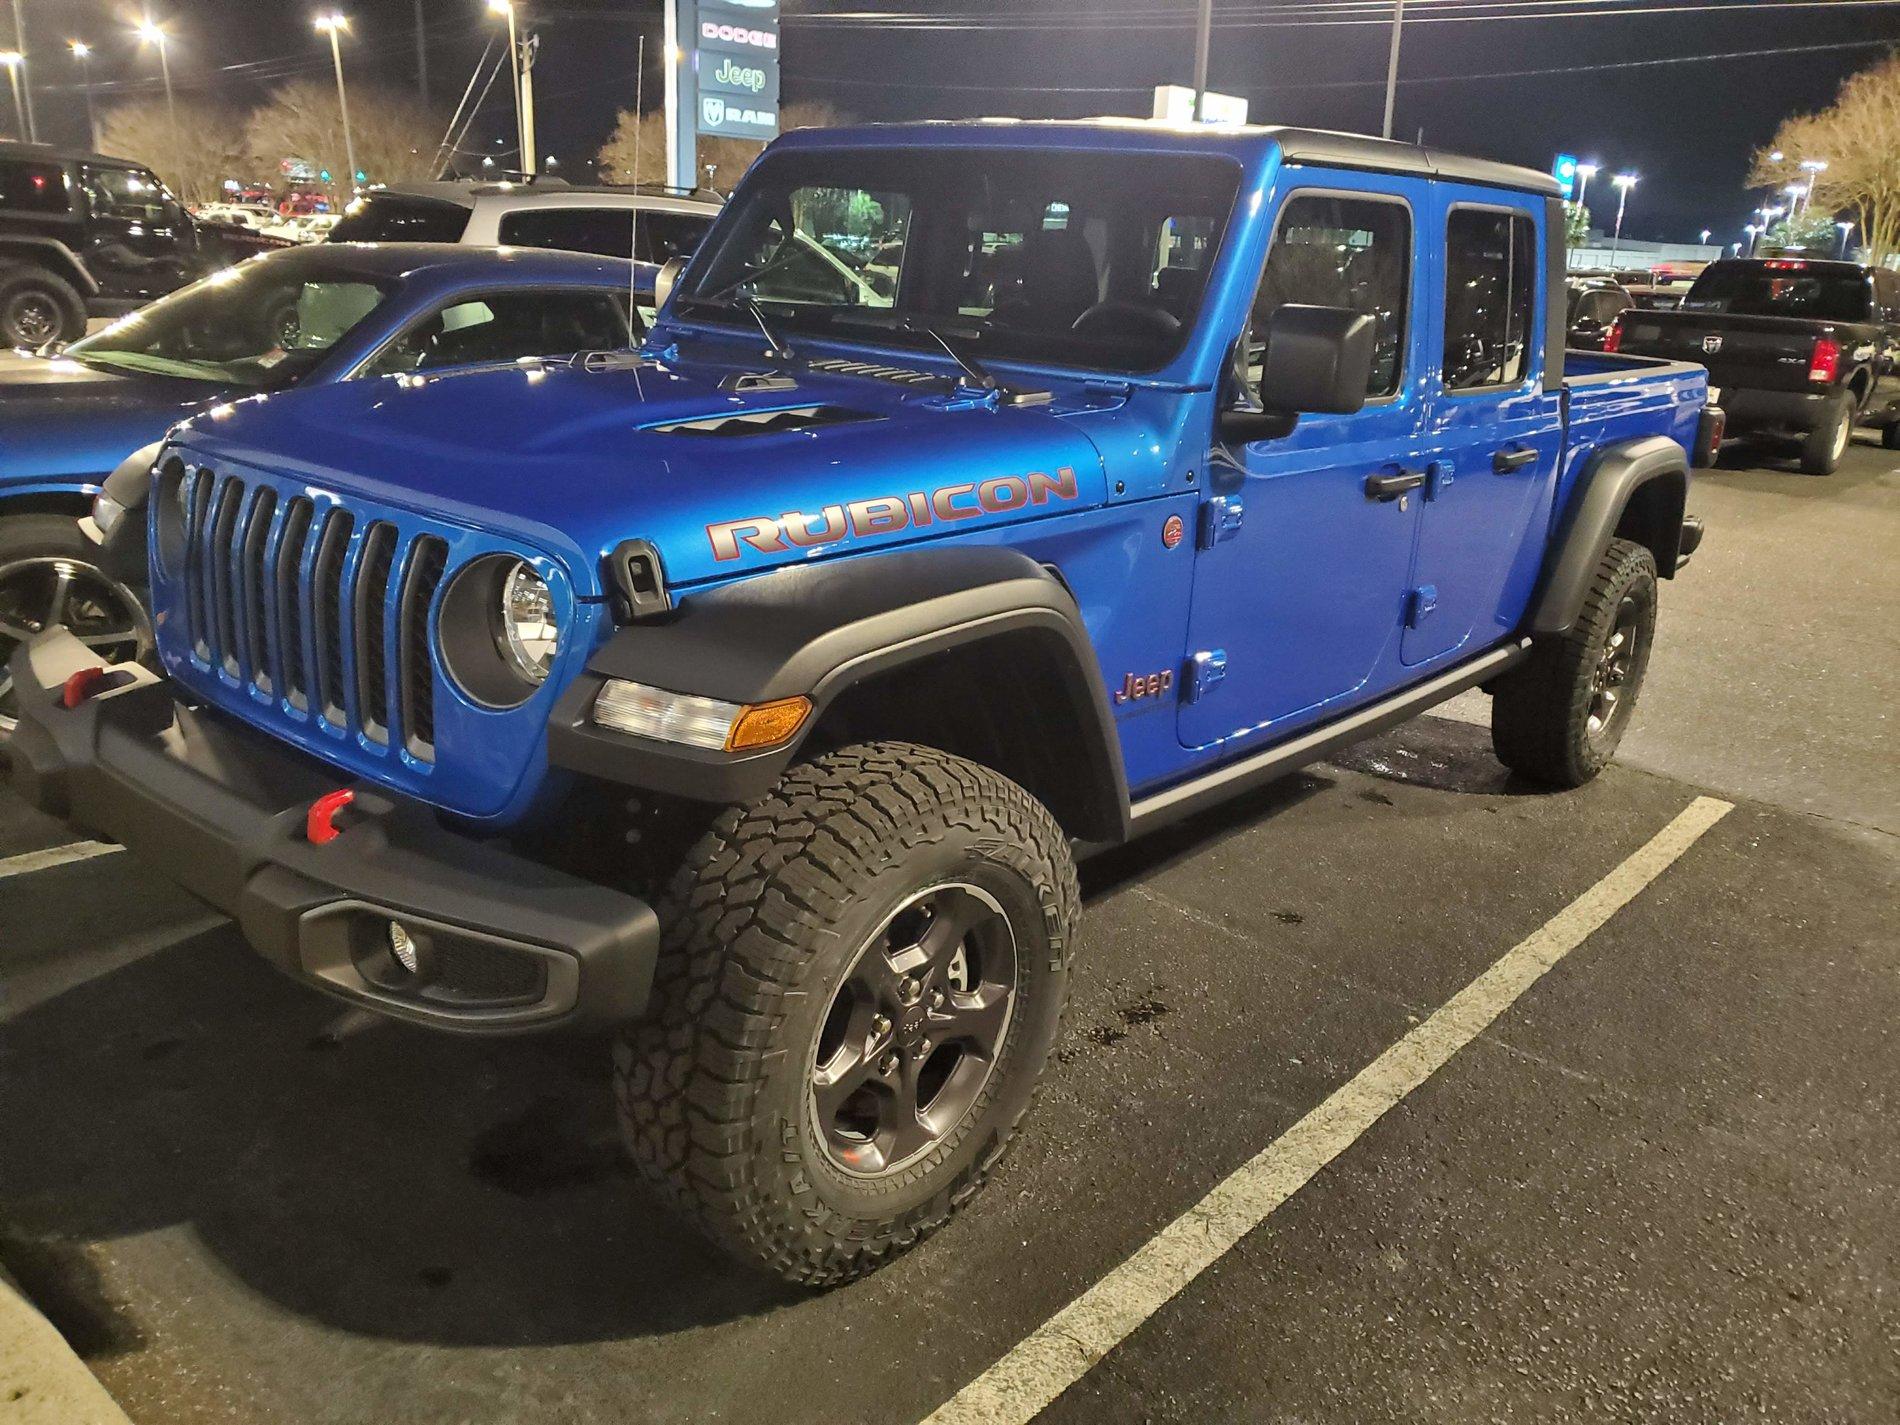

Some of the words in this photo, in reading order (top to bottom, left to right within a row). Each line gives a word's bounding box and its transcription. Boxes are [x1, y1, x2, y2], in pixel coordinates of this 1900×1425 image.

[702, 22, 777, 49] DODGE
[715, 58, 766, 92] Jeep
[725, 107, 776, 126] RAM
[705, 466, 1079, 562] RUBICON
[1114, 669, 1174, 705] Jeep
